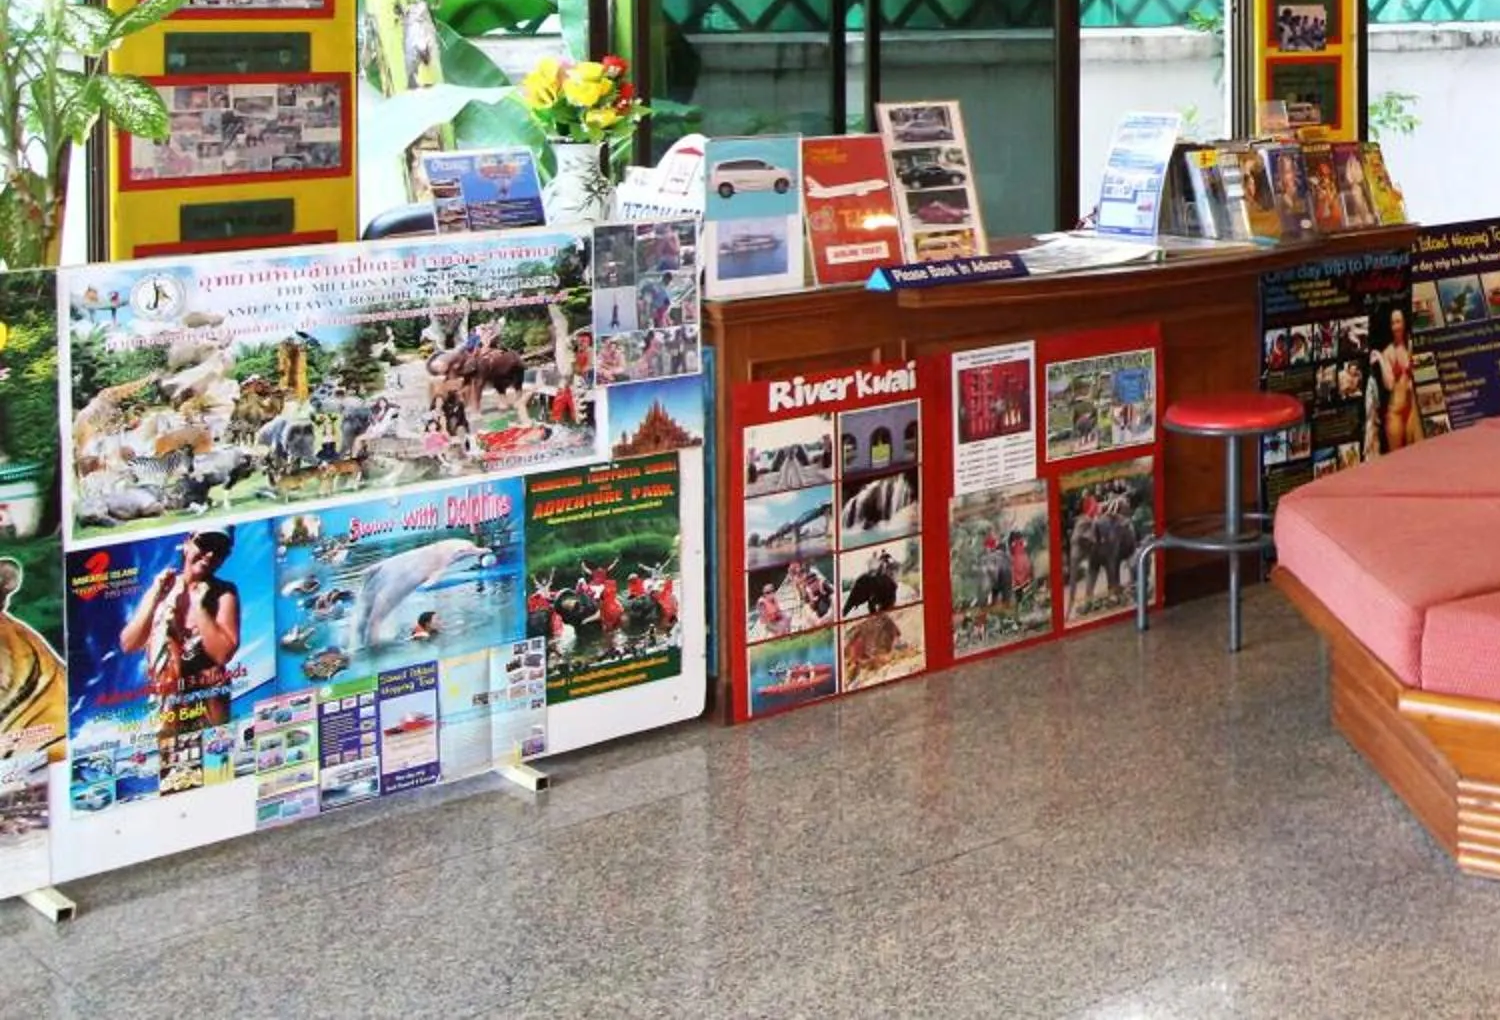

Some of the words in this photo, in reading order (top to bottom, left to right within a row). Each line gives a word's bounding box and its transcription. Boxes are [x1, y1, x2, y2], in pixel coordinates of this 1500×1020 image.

[891, 268, 928, 282] Please
[1297, 263, 1321, 281] day
[1325, 259, 1347, 278] trip
[1349, 257, 1363, 272] to
[768, 375, 853, 412] River
[855, 359, 916, 398] Kwai
[402, 501, 439, 531] with
[445, 483, 513, 536] Dolphins
[532, 489, 623, 520] ADVENTURE
[631, 483, 675, 500] PARK
